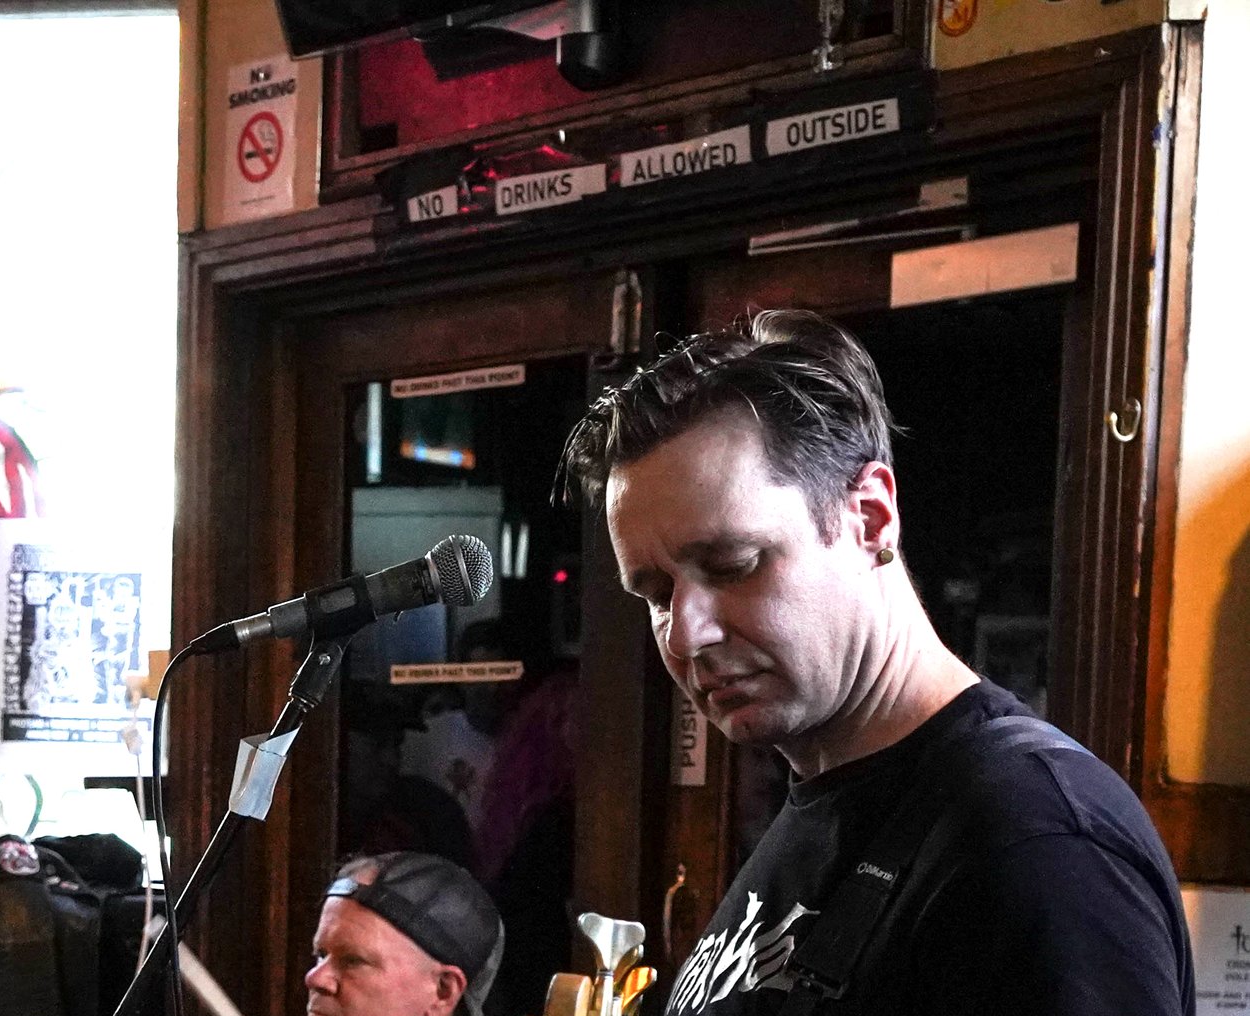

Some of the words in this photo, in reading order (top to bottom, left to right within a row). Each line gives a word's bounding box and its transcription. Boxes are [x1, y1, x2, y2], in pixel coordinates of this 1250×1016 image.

[228, 78, 297, 109] SMOKING
[250, 67, 271, 84] NO
[417, 193, 444, 218] NO
[500, 173, 573, 208] DRINKS
[632, 143, 738, 183] ALLOWED
[786, 103, 887, 147] OUTSIDE
[680, 699, 696, 768] PUSH
